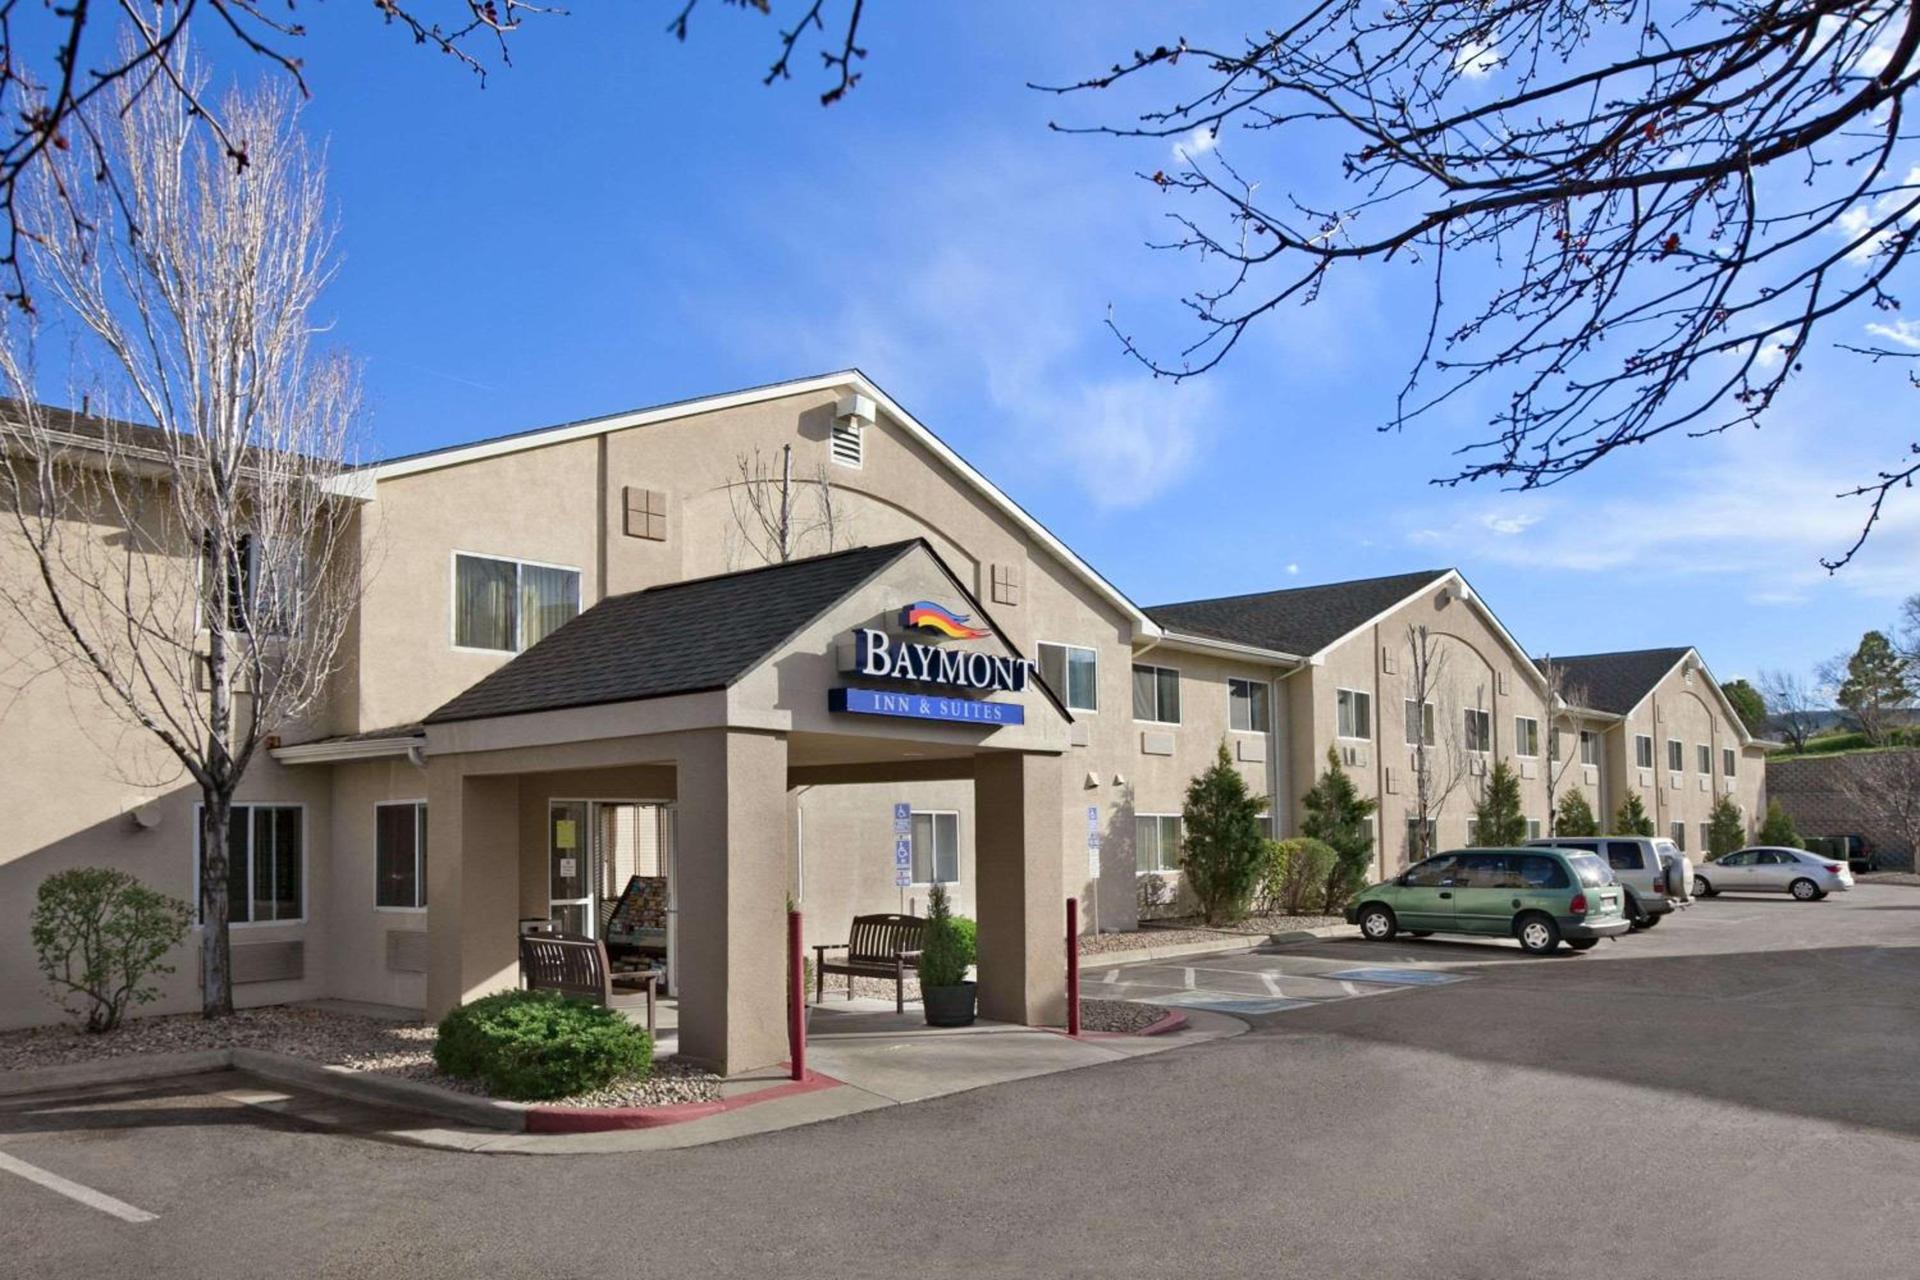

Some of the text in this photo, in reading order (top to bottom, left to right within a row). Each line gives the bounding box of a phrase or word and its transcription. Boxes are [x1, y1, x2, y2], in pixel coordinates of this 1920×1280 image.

[862, 628, 1034, 692] BAYMONT
[873, 694, 1002, 719] INN & SUITES
